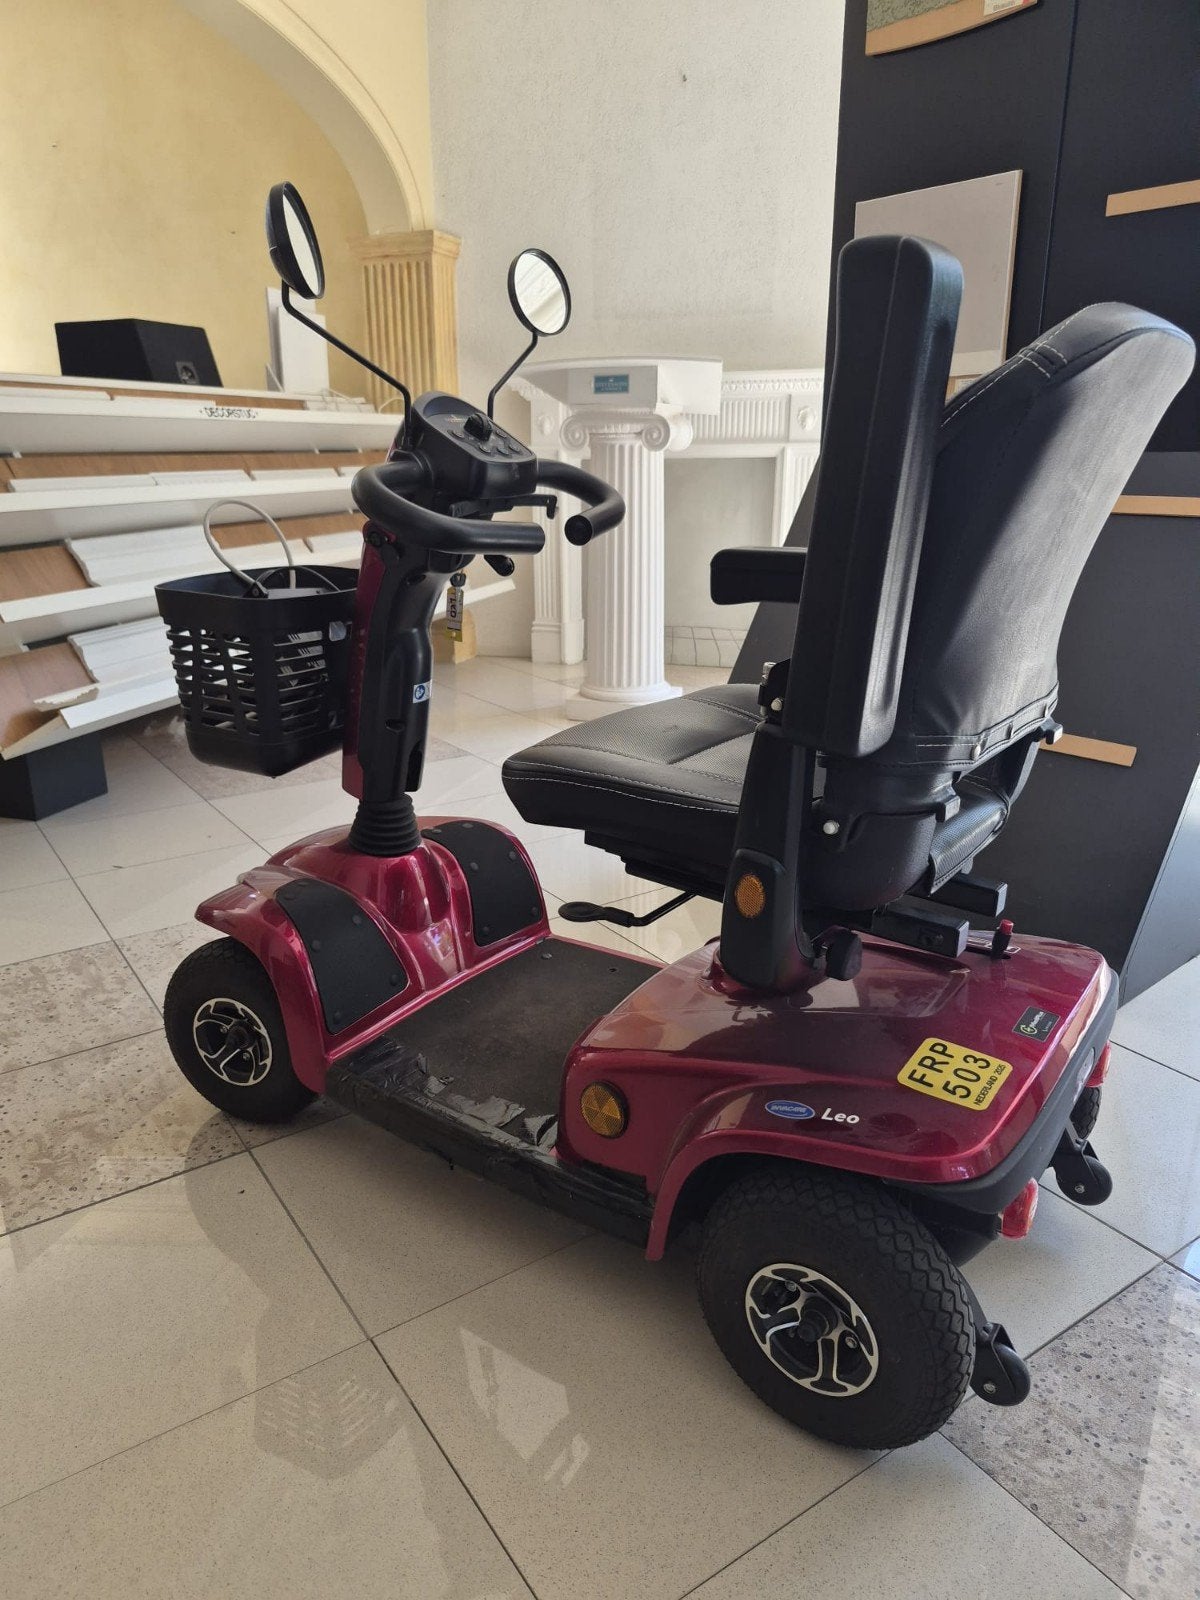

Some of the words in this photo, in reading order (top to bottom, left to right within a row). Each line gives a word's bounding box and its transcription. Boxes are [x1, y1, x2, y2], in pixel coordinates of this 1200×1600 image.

[907, 1042, 955, 1088] FRP
[942, 1054, 991, 1099] 503
[973, 1075, 998, 1106] NEDERLAND
[821, 1107, 860, 1124] Leo
